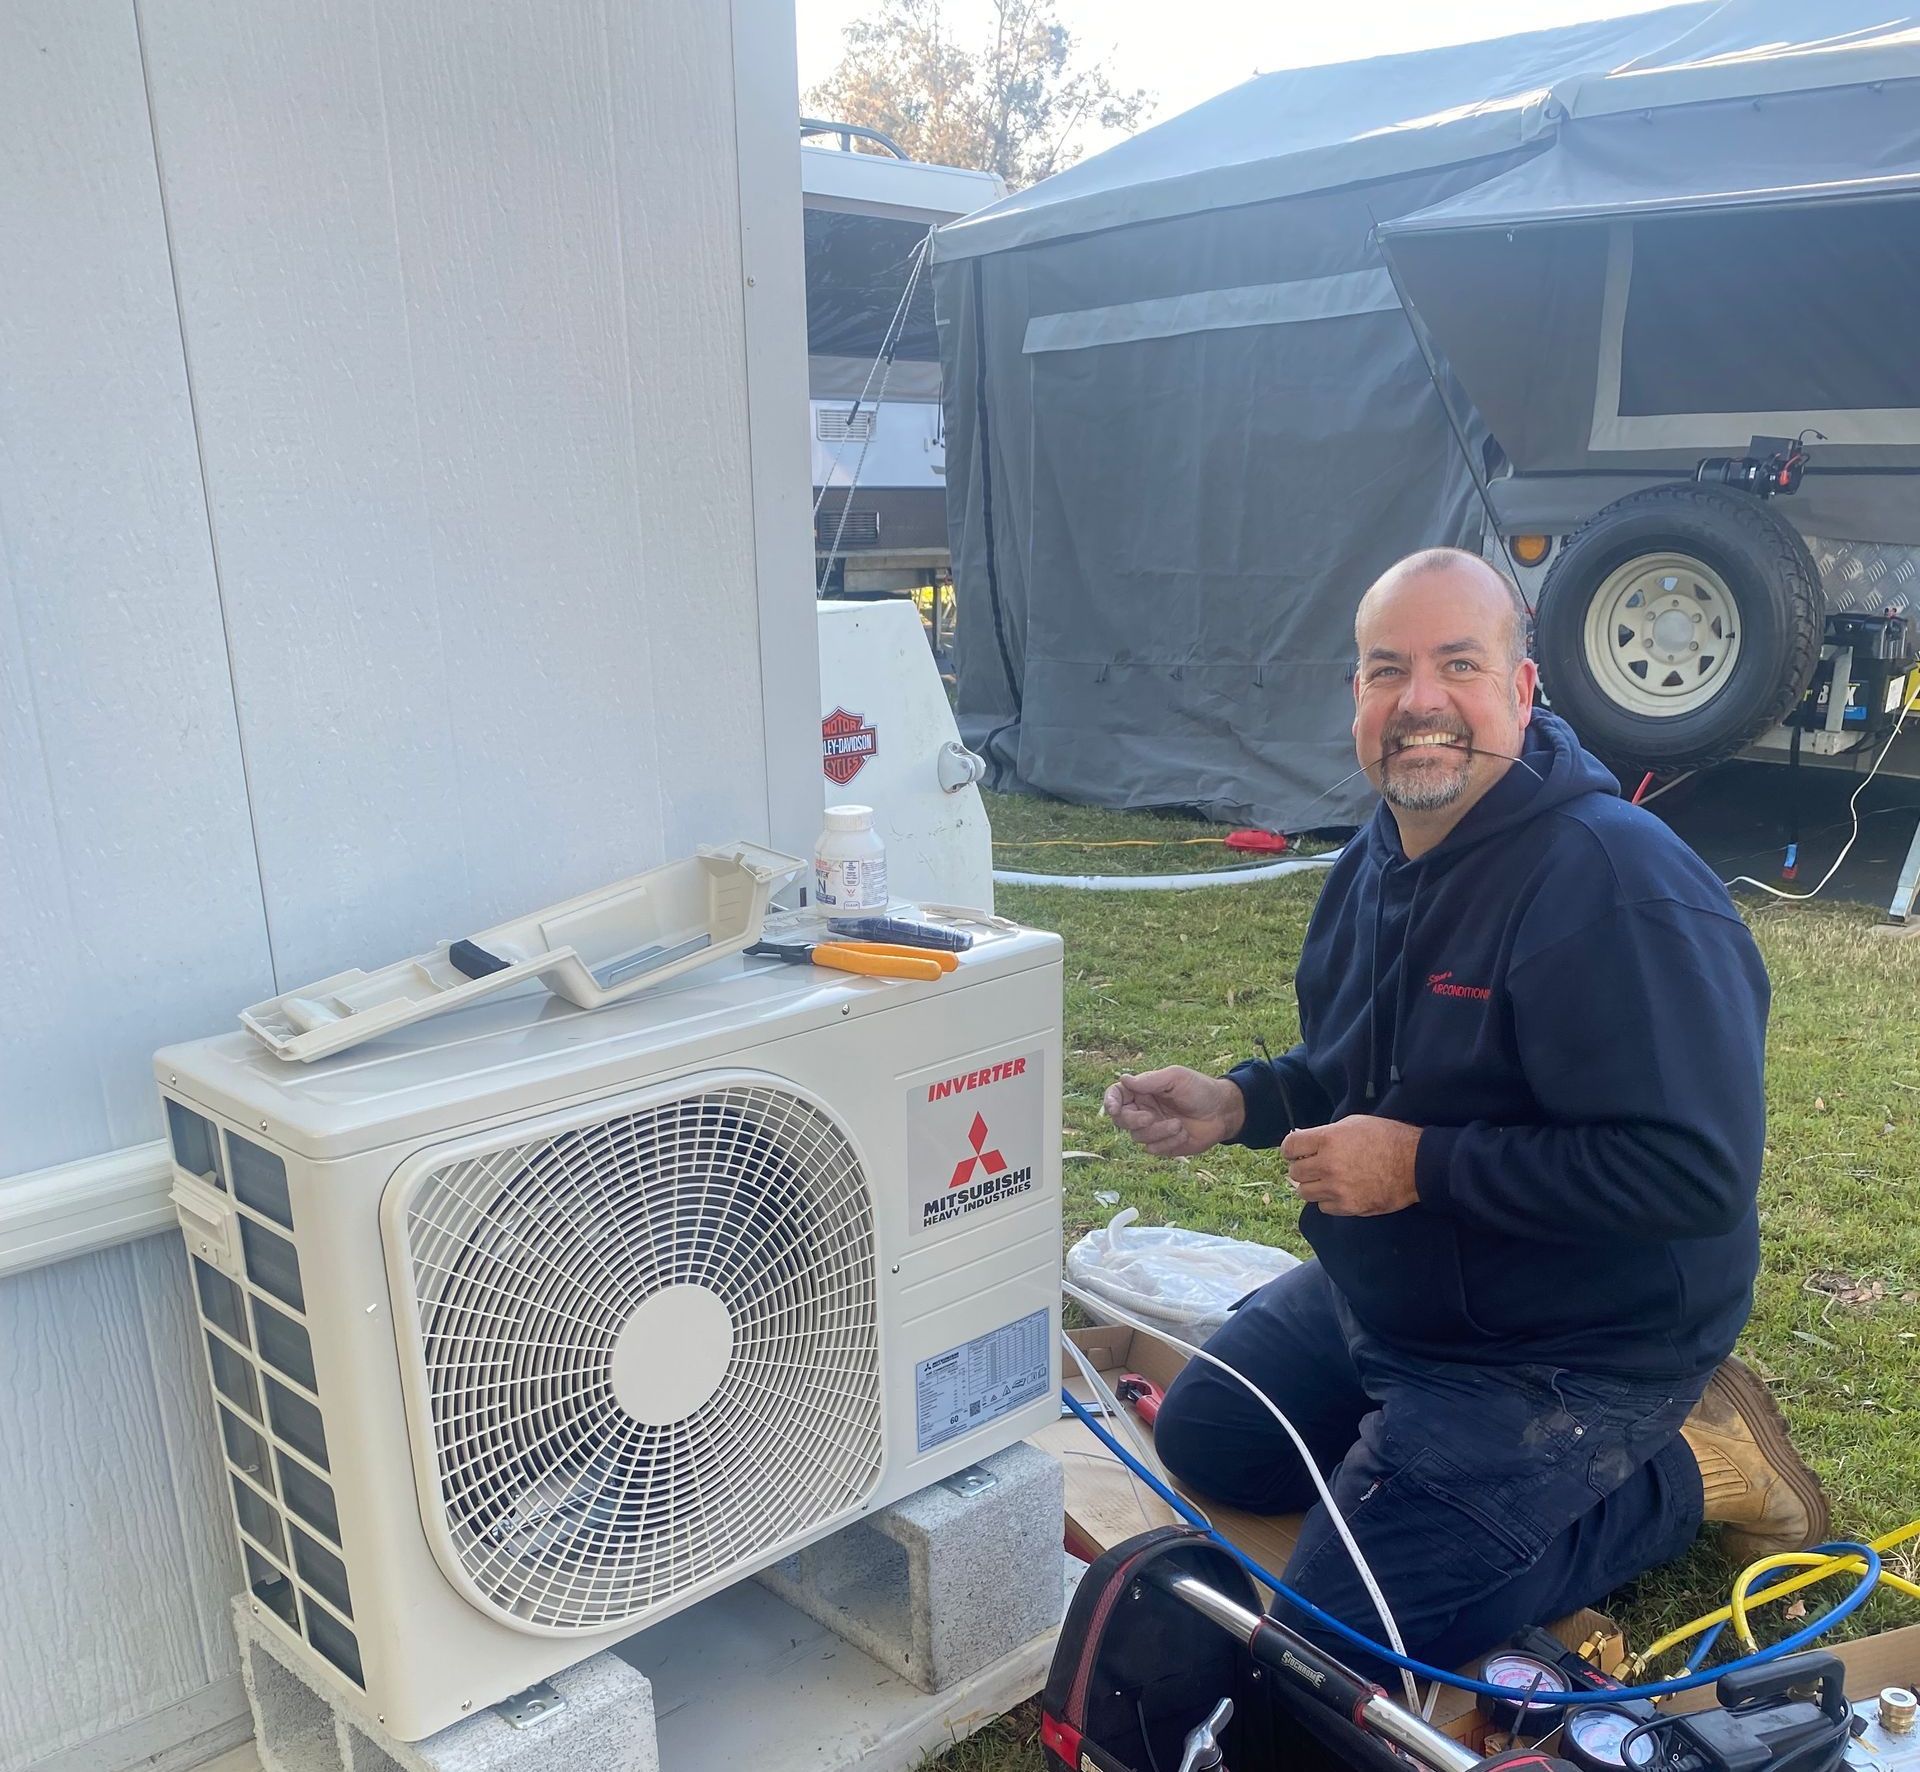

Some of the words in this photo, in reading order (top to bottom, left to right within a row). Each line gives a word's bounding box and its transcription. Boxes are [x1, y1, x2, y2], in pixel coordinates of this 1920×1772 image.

[823, 717, 857, 735] MOTOR
[823, 733, 872, 756] LEY-DAVIDSON
[825, 756, 860, 778] CYCLES
[928, 1057, 1026, 1103] INVERTER
[923, 1166, 1032, 1218] MITSUBISHI
[923, 1206, 961, 1228] HEAVY
[963, 1180, 1032, 1213] INDUSTRIES
[950, 1415, 959, 1424] 60
